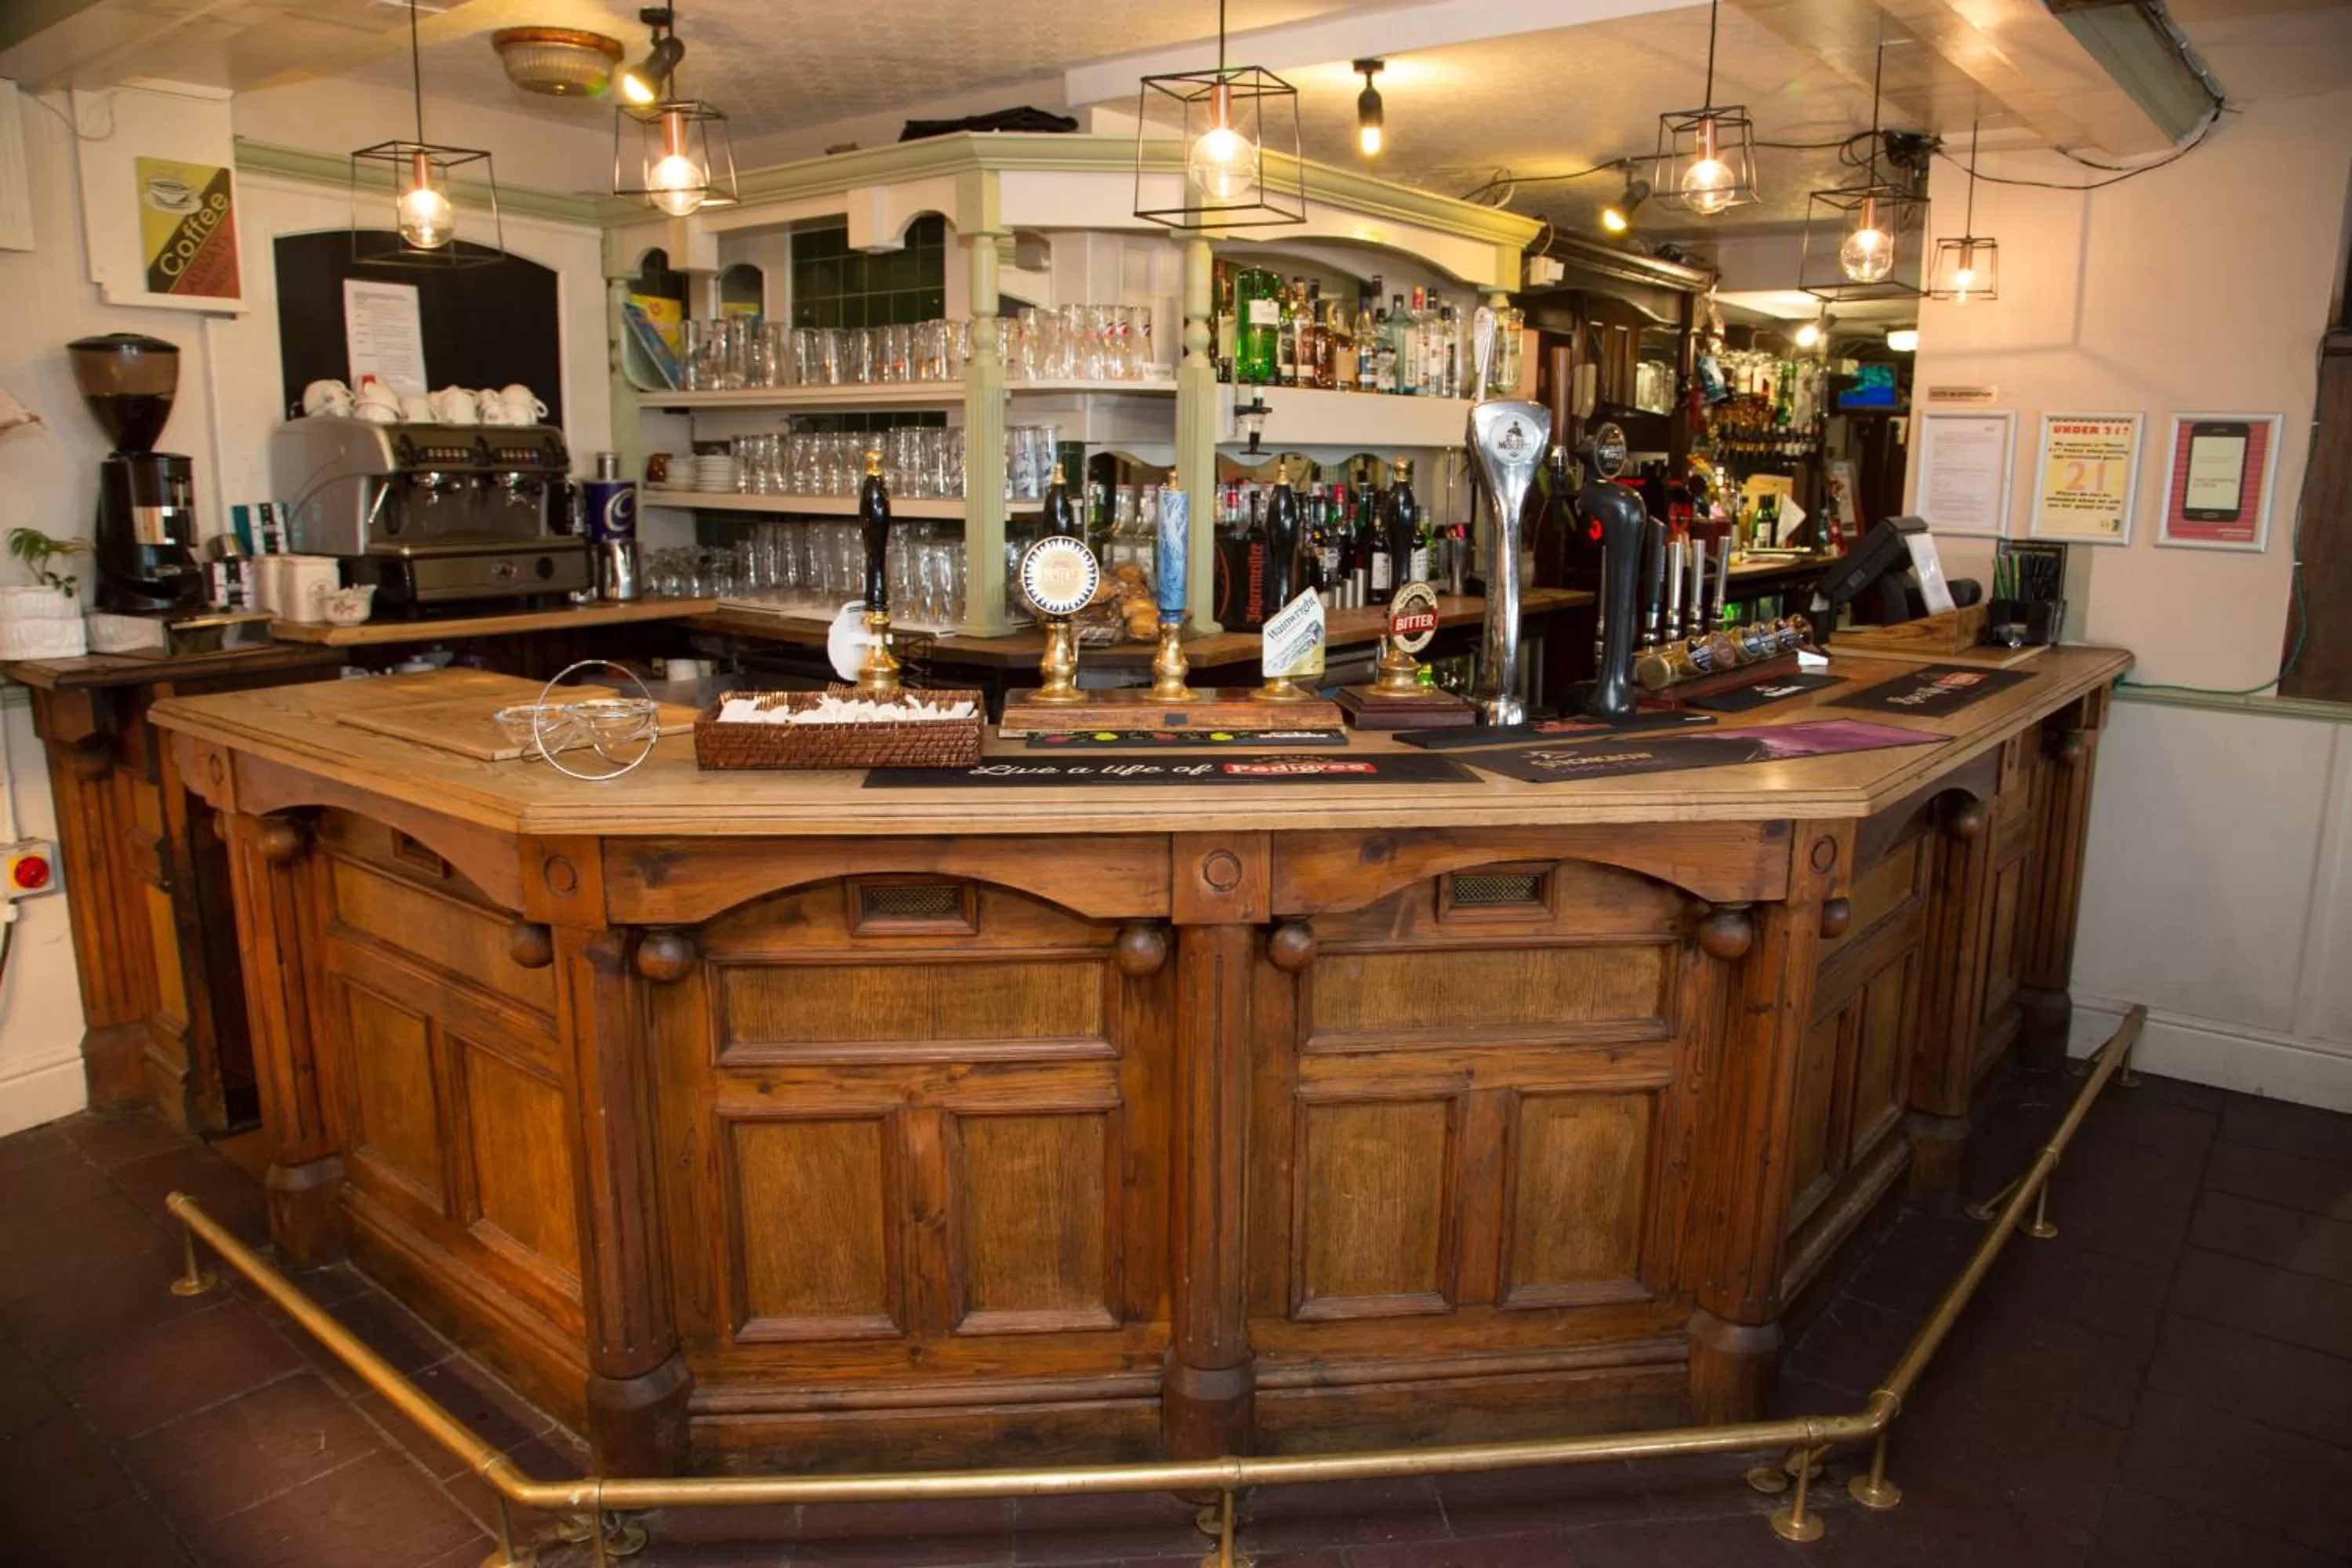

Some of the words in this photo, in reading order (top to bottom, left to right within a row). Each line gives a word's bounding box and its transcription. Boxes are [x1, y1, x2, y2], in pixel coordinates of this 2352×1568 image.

[159, 193, 227, 276] Coffee
[2053, 425, 2100, 434] UNDER
[2065, 460, 2107, 492] 21
[1396, 614, 1434, 631] BITTER
[968, 763, 1060, 776] Live
[1066, 765, 1094, 775] a
[1101, 764, 1165, 776] life
[1171, 763, 1215, 776] of
[1230, 762, 1367, 775] Pedigree
